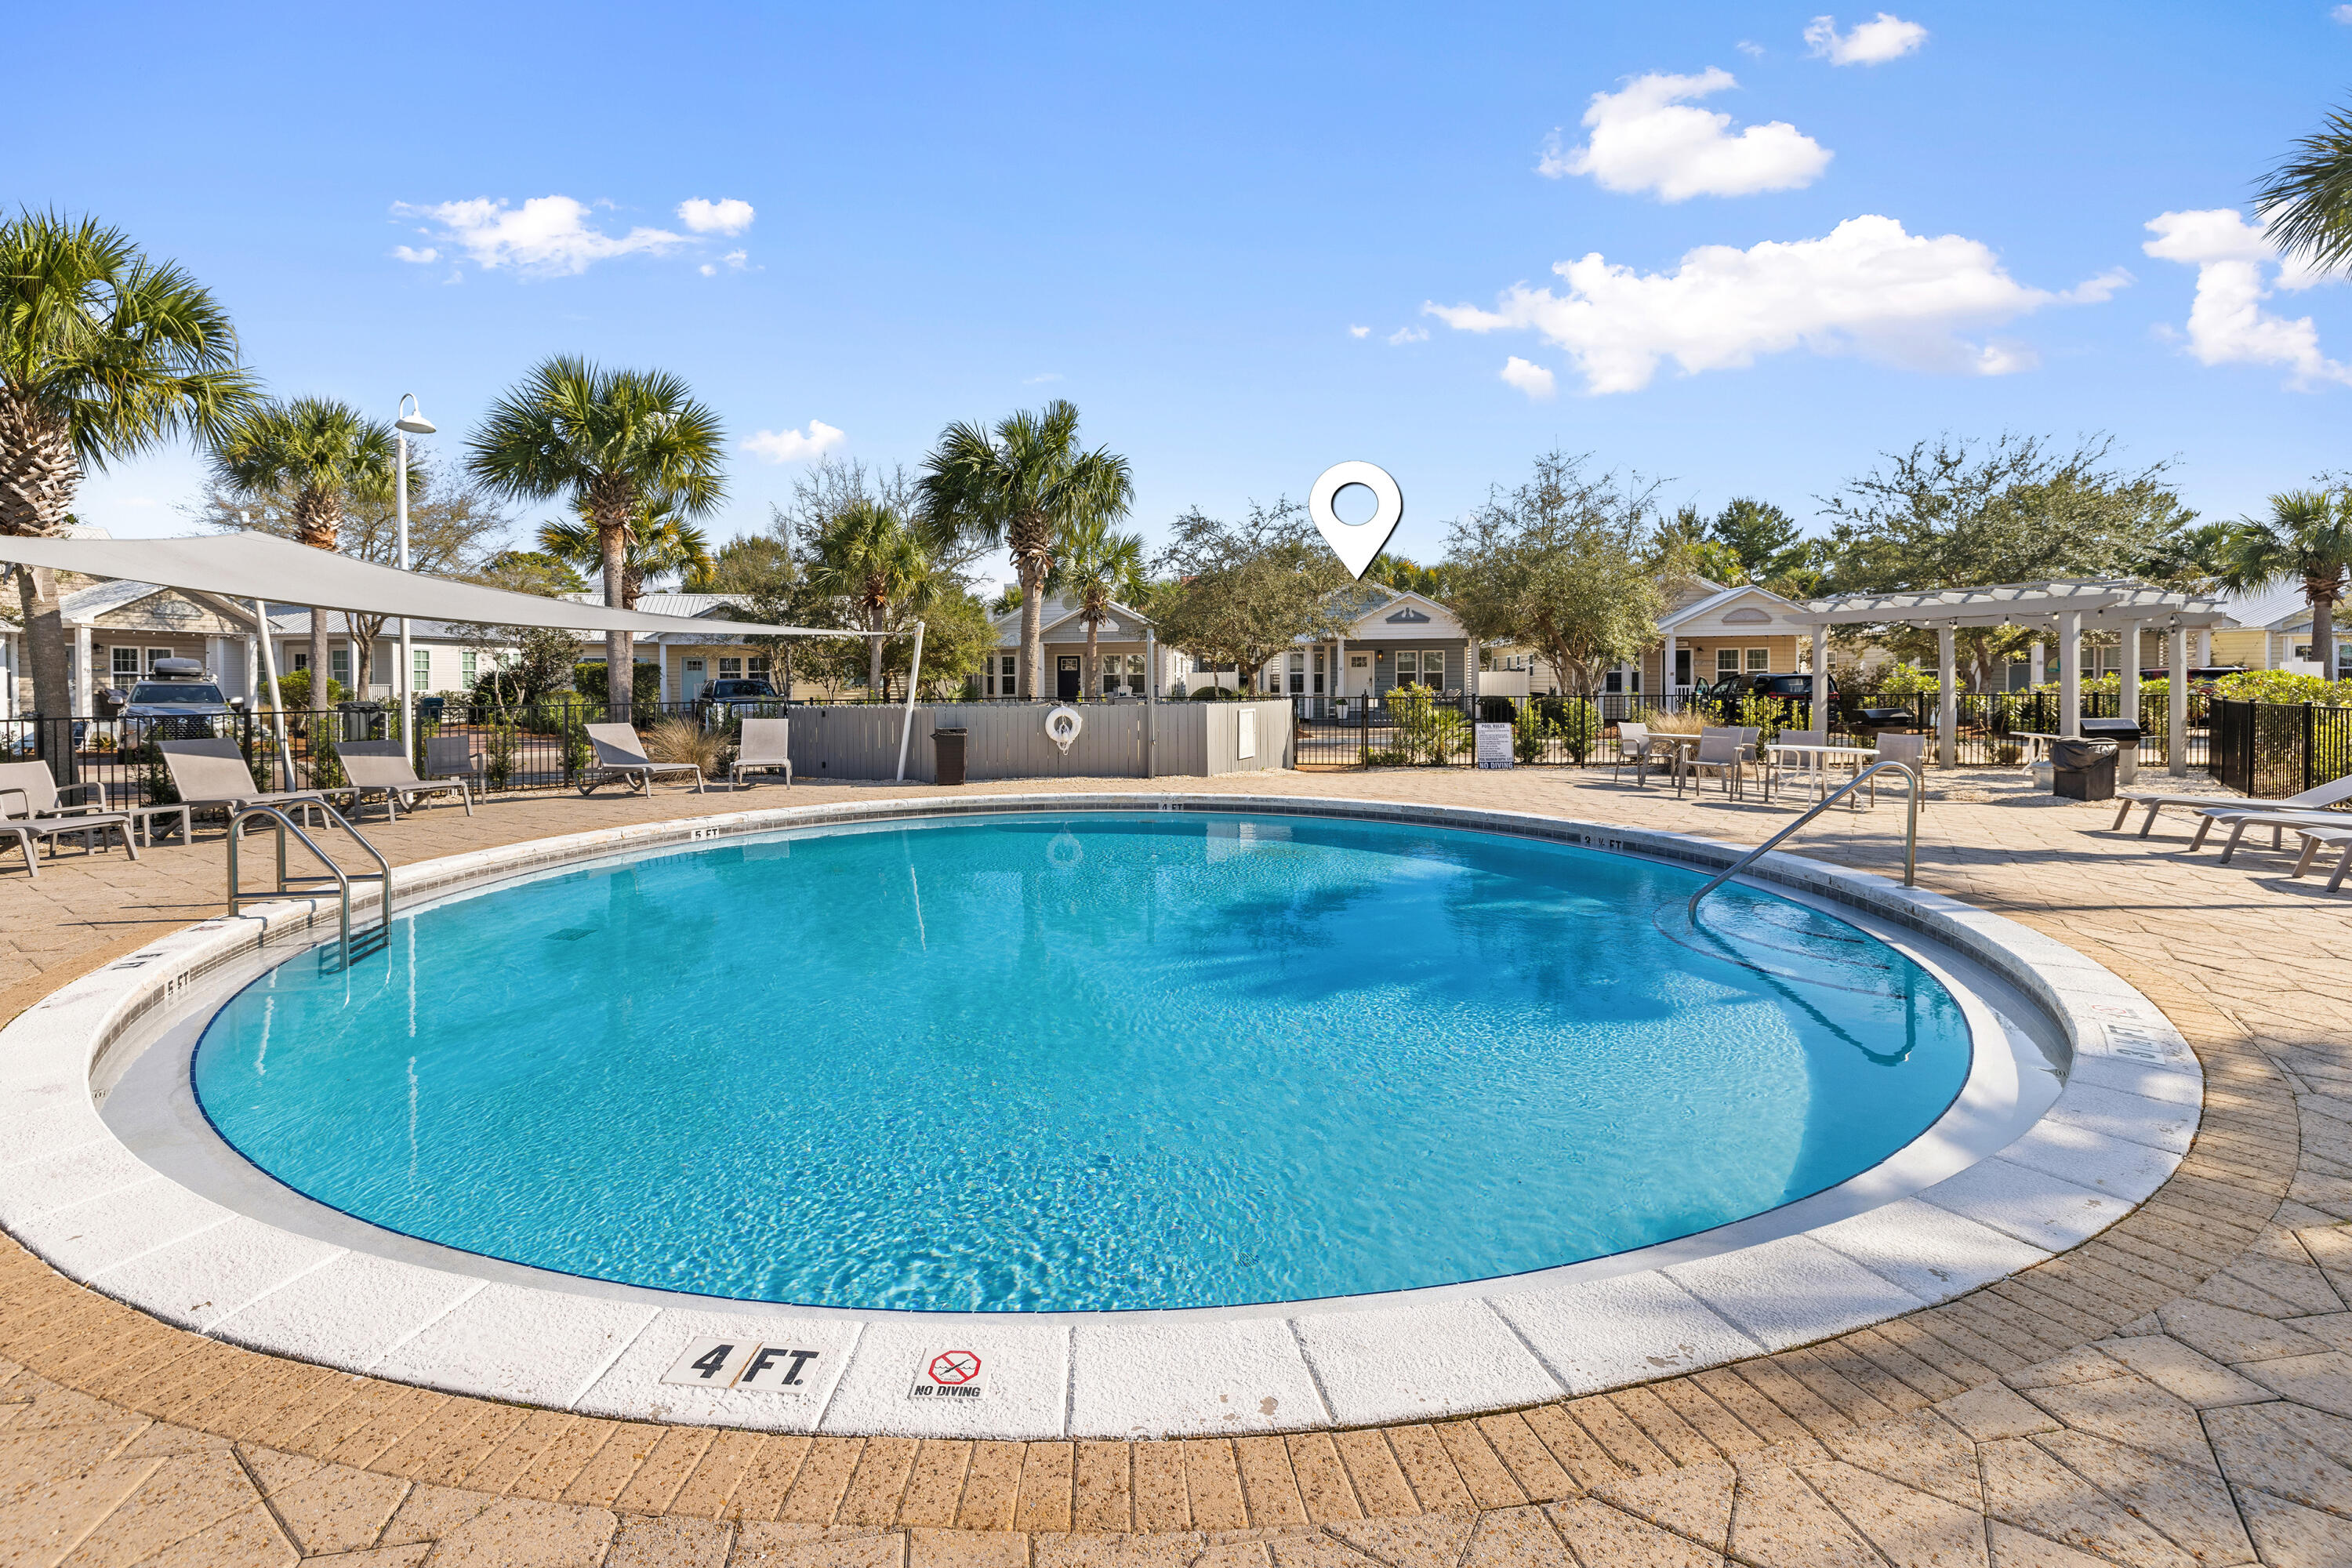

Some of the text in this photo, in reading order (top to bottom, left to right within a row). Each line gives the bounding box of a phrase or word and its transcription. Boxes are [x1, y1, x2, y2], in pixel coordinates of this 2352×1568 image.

[706, 828, 717, 837] FT
[1610, 839, 1622, 848] FT
[177, 971, 189, 989] FT
[691, 1344, 820, 1386] 4 FT.
[914, 1385, 981, 1397] NO DIVING
